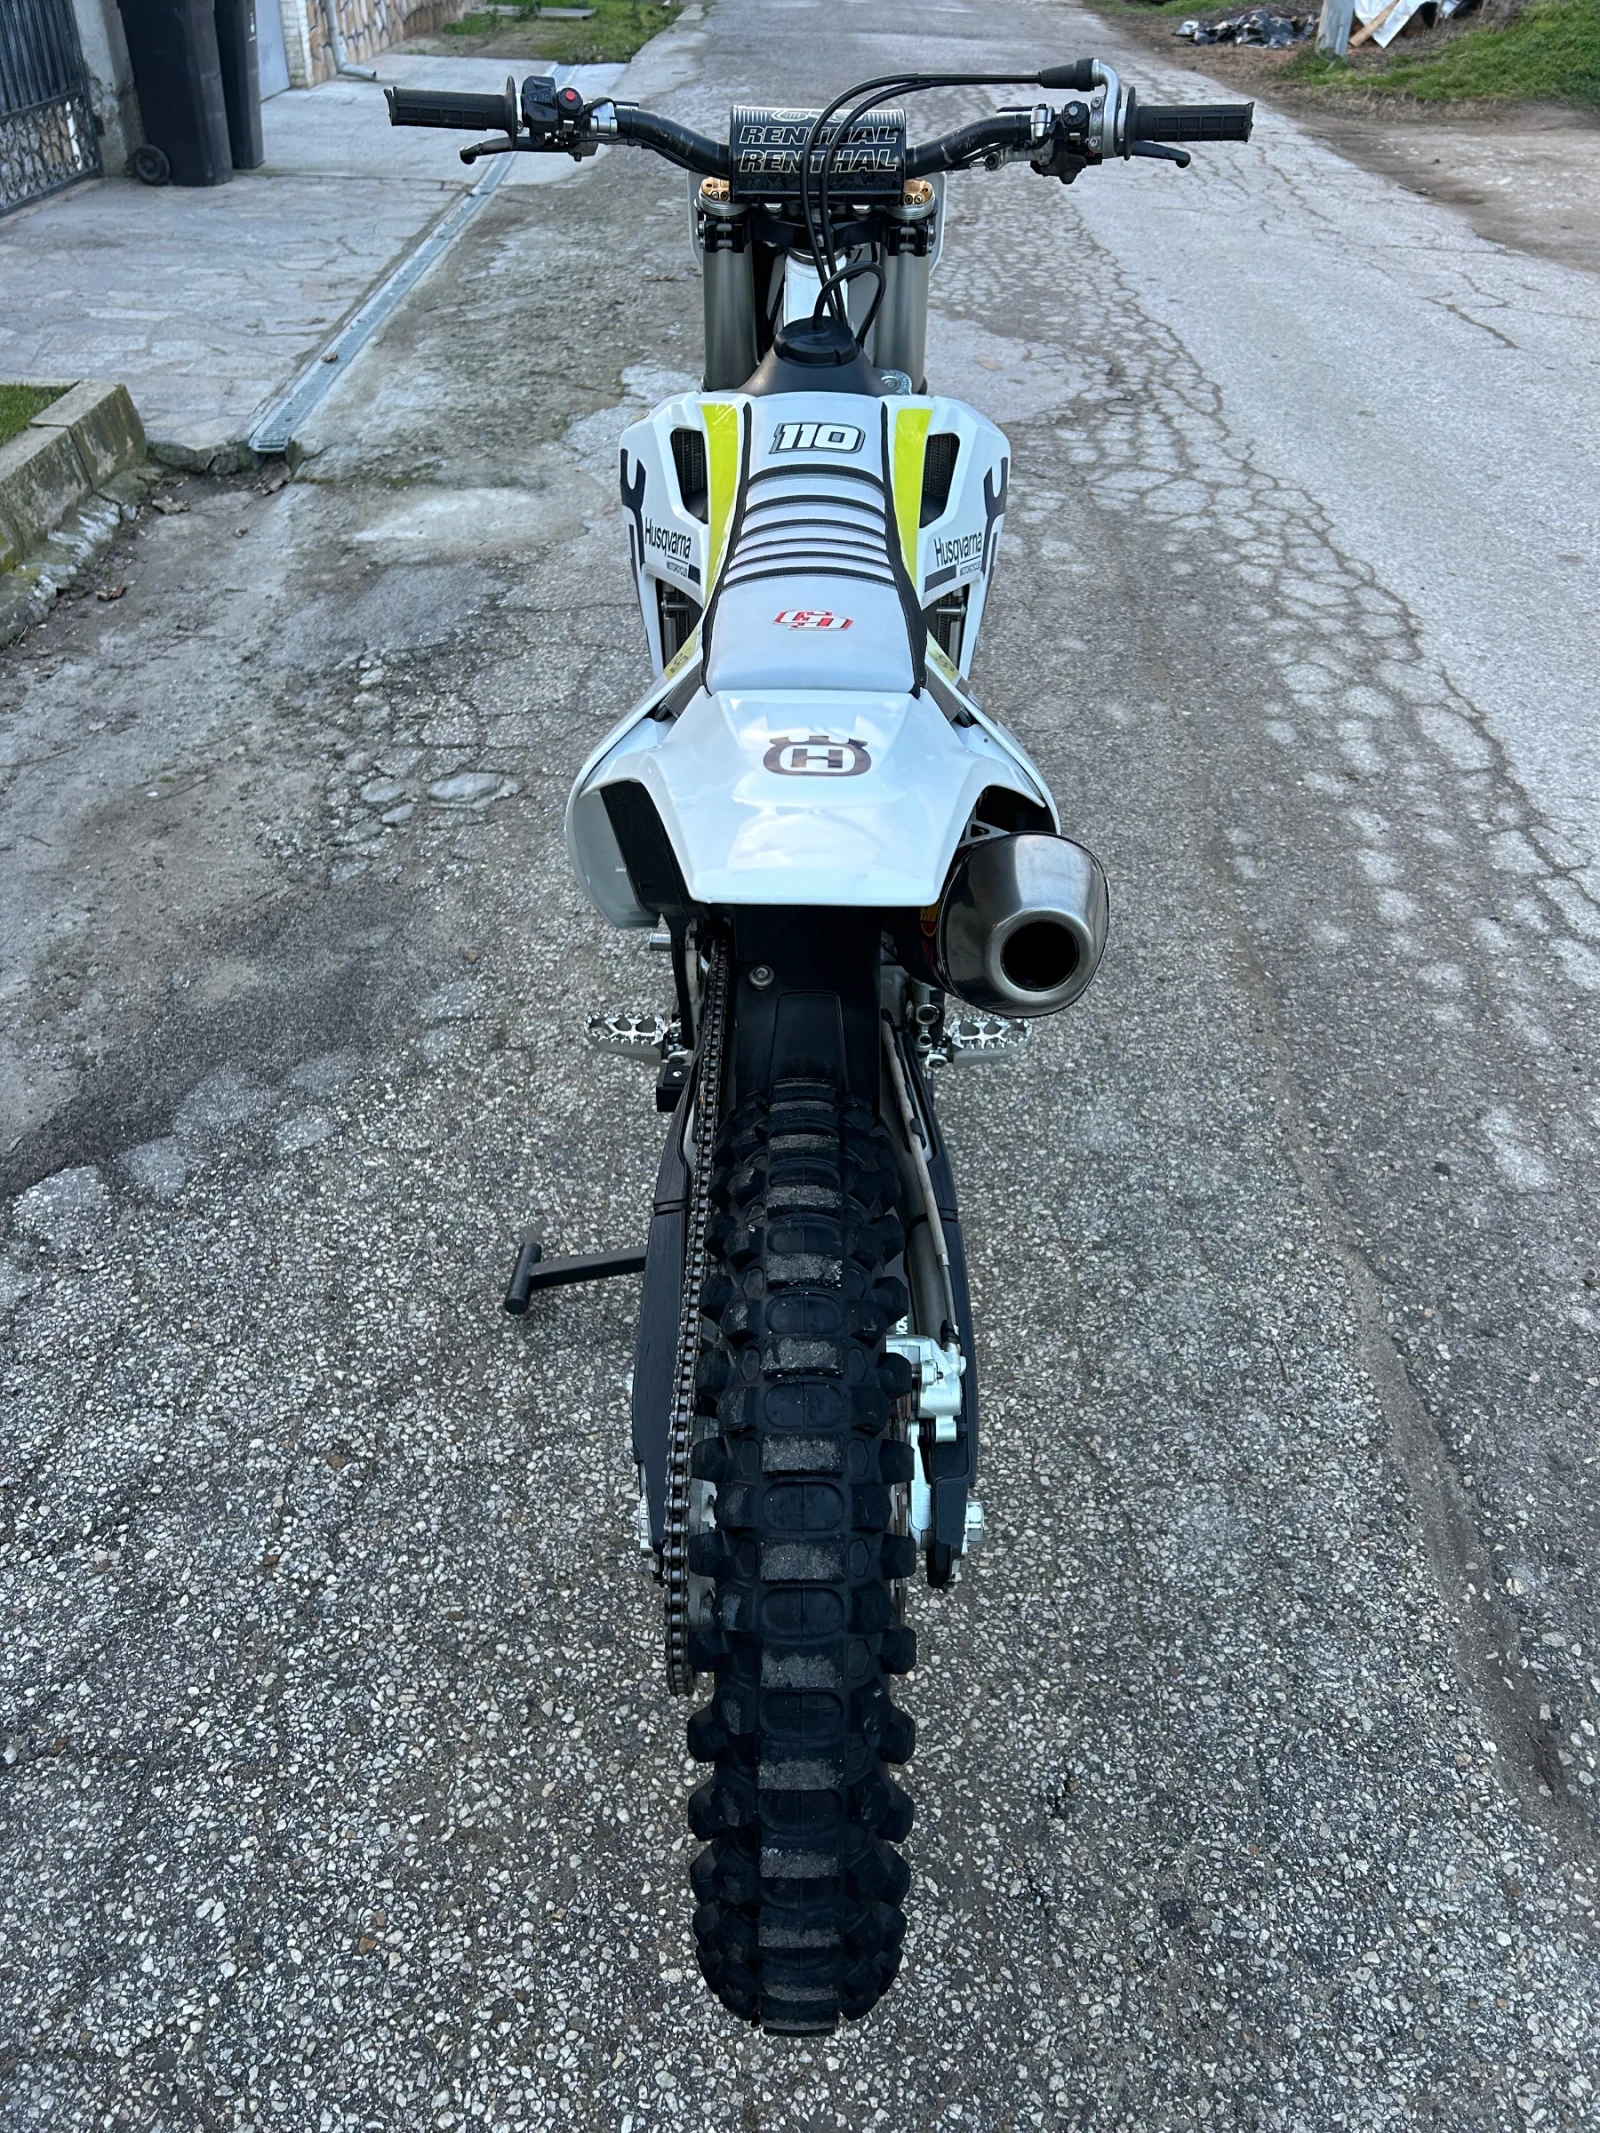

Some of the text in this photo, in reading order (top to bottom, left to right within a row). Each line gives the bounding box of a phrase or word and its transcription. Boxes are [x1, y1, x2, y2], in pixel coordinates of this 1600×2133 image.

[772, 422, 864, 453] 110
[645, 517, 692, 559] Husqvarna
[933, 531, 982, 568] Husqvarna
